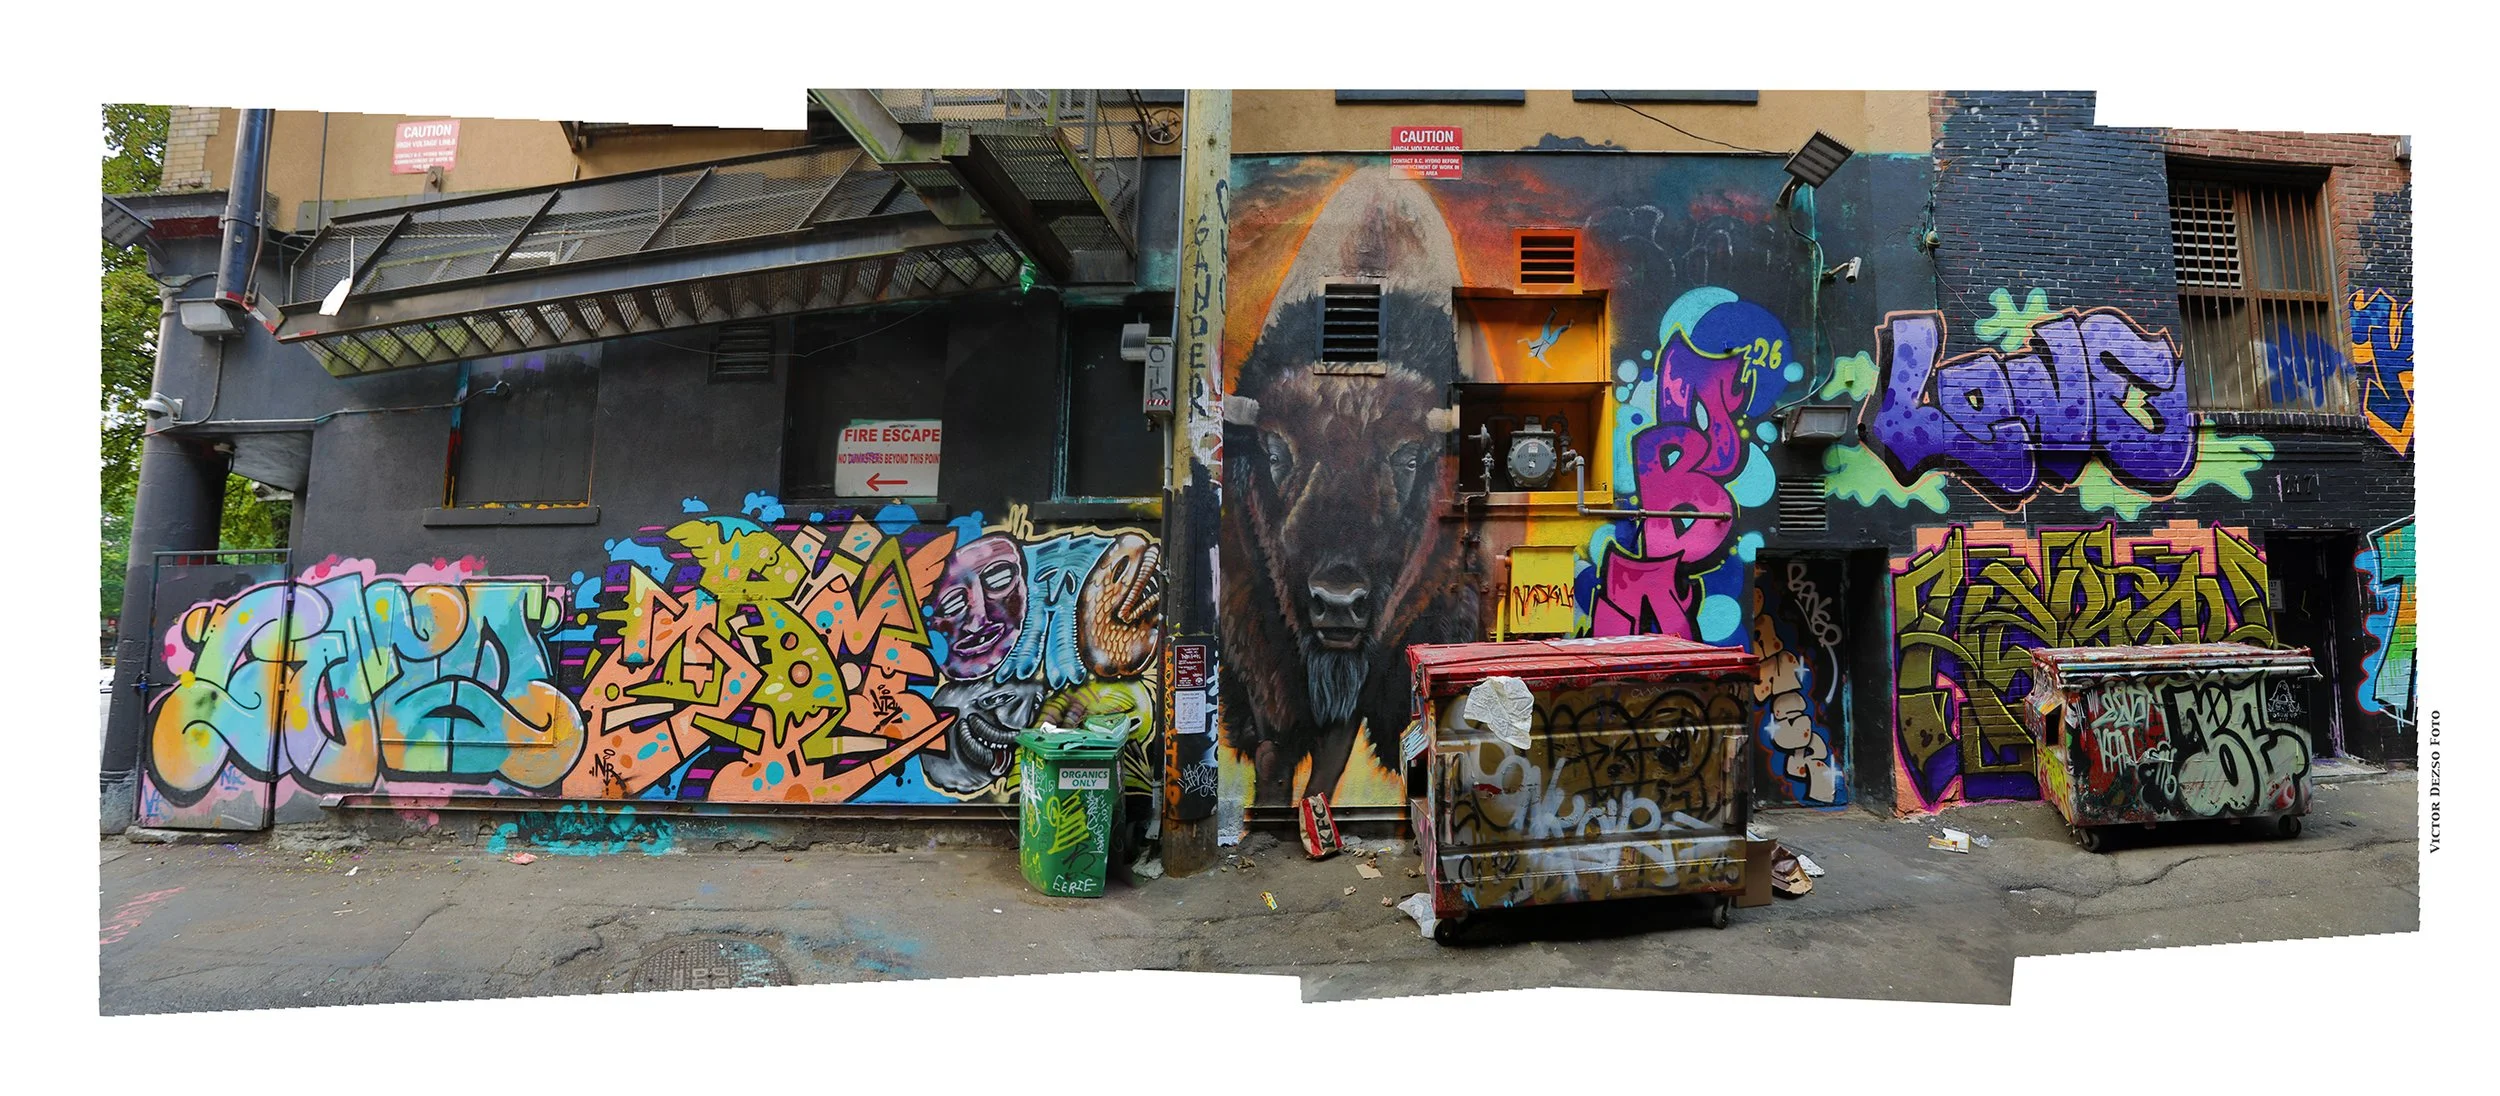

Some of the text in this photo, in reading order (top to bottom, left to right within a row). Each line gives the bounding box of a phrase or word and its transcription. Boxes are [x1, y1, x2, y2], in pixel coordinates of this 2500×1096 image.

[404, 124, 452, 138] CAUTION
[1400, 130, 1454, 143] CAUTION
[844, 429, 940, 442] FIRE ESCAPE
[838, 453, 847, 464] NO
[885, 453, 909, 464] BEYOND
[910, 453, 925, 464] THIS
[1061, 770, 1108, 779] ORGANICS
[1072, 779, 1097, 787] ONLY
[1312, 803, 1337, 850] KFC
